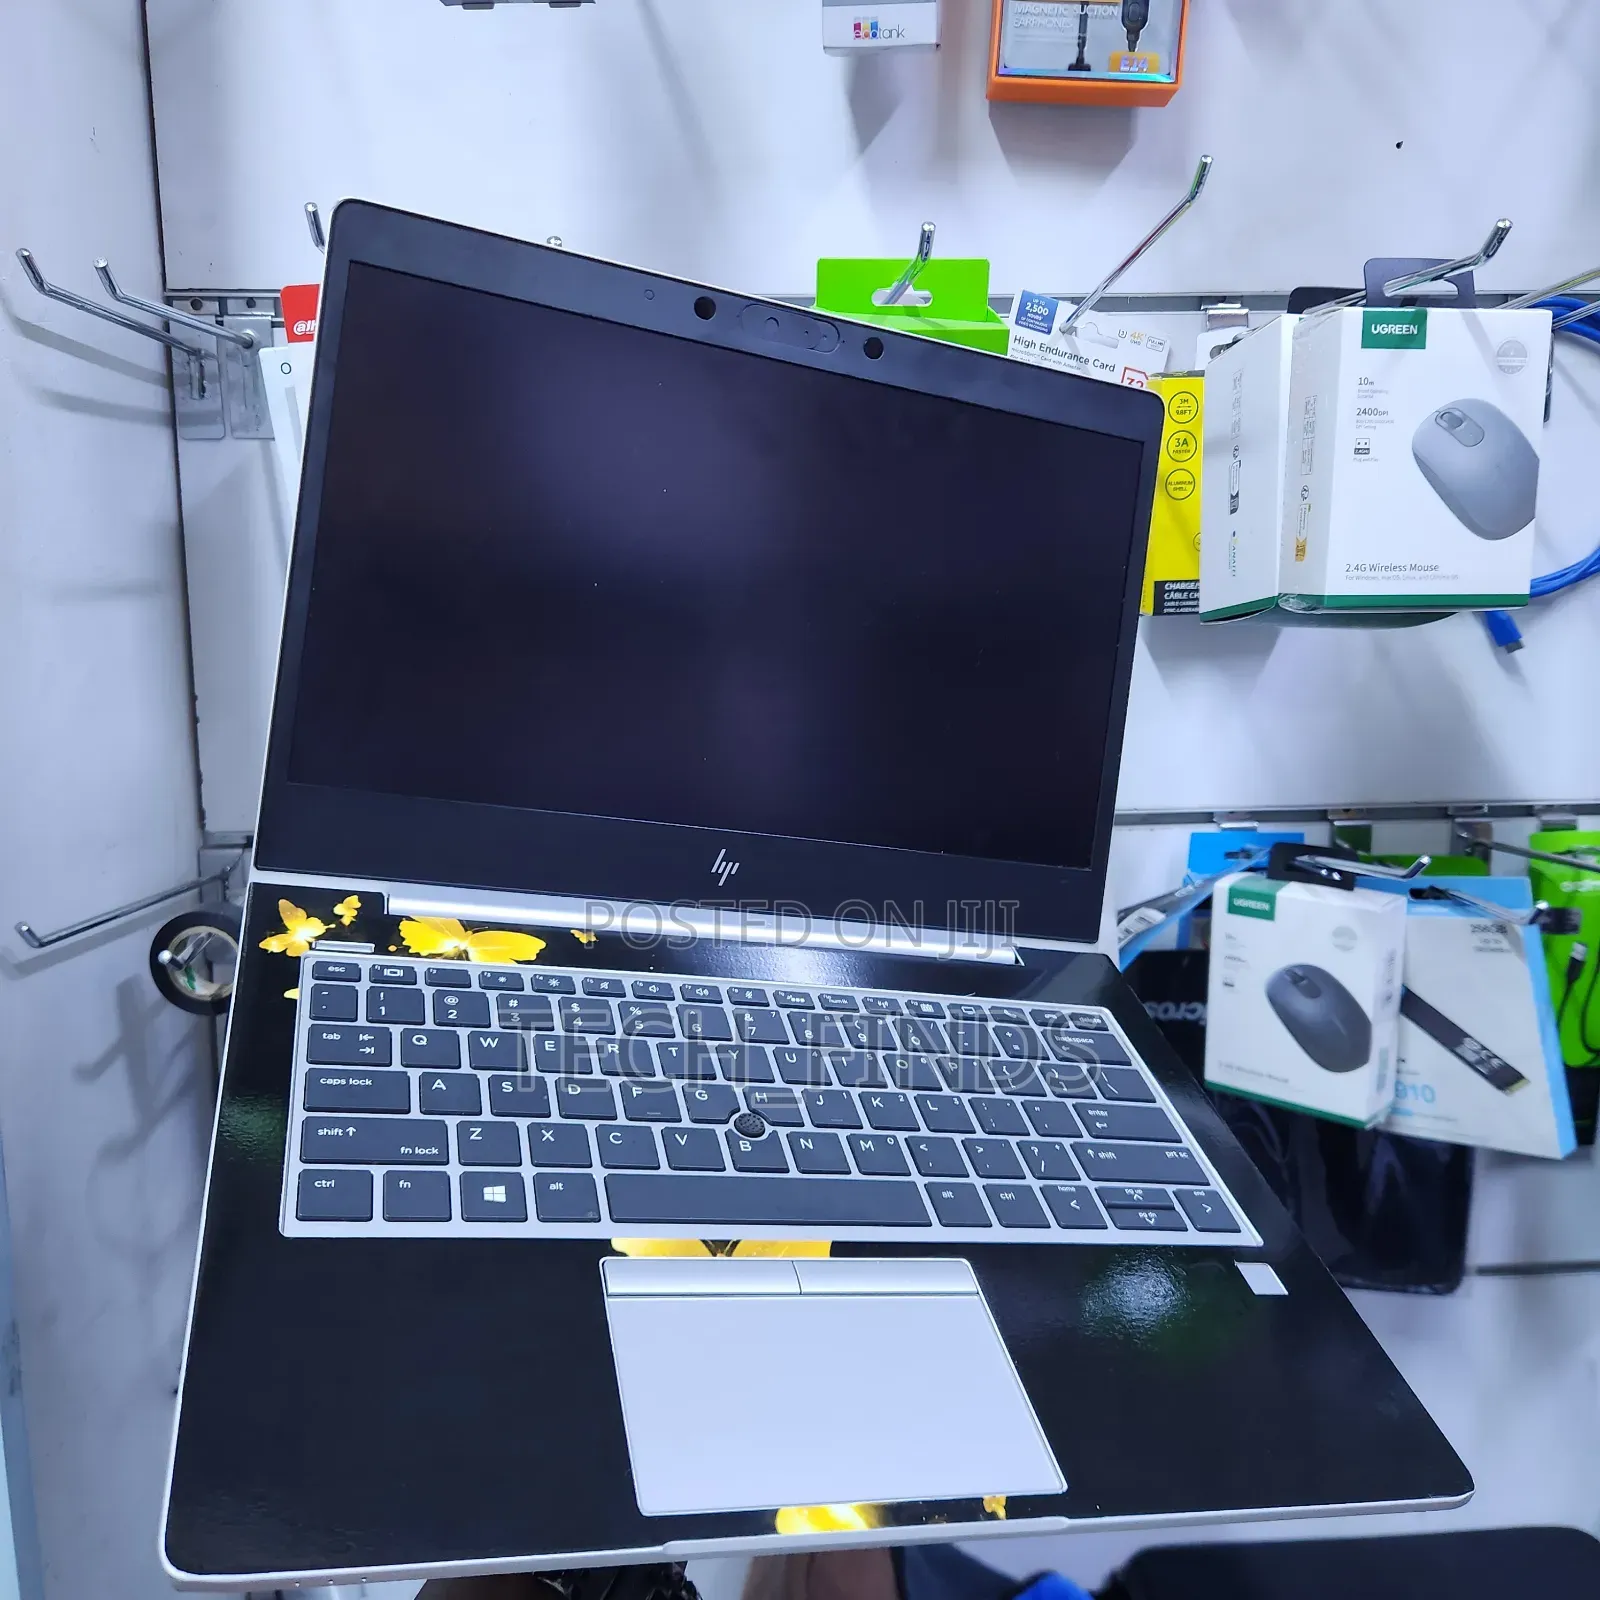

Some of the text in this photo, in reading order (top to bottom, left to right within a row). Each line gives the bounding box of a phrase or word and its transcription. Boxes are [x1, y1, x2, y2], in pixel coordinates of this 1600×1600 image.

[1014, 4, 1119, 17] MAGNETIC SUCTION
[1120, 55, 1149, 72] E14
[1025, 302, 1049, 316] 2,500
[1371, 323, 1418, 335] UGREEN
[1013, 334, 1036, 350] High
[1039, 343, 1090, 365] Endurance
[1092, 358, 1116, 373] Card
[1175, 438, 1189, 448] 3A
[1345, 562, 1440, 573] 2.4G Wireless Mouse
[1233, 897, 1271, 912] UGREEN
[327, 965, 346, 973] esc
[379, 1006, 386, 1016] 1
[447, 1010, 458, 1019] 2
[510, 1012, 521, 1022] 3
[573, 1017, 583, 1026] 4
[634, 1021, 644, 1030] 5
[691, 1024, 702, 1033] 6
[322, 1032, 341, 1041] tab
[747, 1027, 756, 1036] 7
[804, 1030, 814, 1039] 8
[412, 1034, 427, 1046] Q
[479, 1037, 498, 1048] W
[857, 1033, 867, 1042] 9
[1054, 1034, 1095, 1044] backspace
[545, 1040, 556, 1051] E
[608, 1044, 619, 1054] R
[668, 1047, 679, 1057] T
[728, 1050, 739, 1060] Y
[785, 1053, 797, 1063] U
[841, 1056, 848, 1067] I
[896, 1060, 908, 1069] O
[319, 1077, 373, 1086] caps lock
[432, 1079, 446, 1090] A
[502, 1081, 513, 1093] S
[568, 1084, 581, 1094] D
[632, 1086, 643, 1098] F
[695, 1089, 708, 1100] G
[755, 1092, 768, 1103] H
[816, 1095, 824, 1105] J
[871, 1096, 884, 1107] K
[926, 1100, 938, 1111] L
[1088, 1109, 1108, 1117] enter
[317, 1126, 344, 1137] shift
[469, 1128, 483, 1140] Z
[541, 1129, 555, 1142] X
[609, 1132, 623, 1145] C
[675, 1134, 688, 1146] V
[739, 1141, 751, 1151] B
[800, 1138, 813, 1150] N
[859, 1140, 875, 1151] M
[400, 1146, 439, 1155] fn lock
[1098, 1151, 1117, 1160] shift
[1165, 1151, 1178, 1159] prt
[314, 1179, 335, 1188] ctrl
[399, 1180, 411, 1189] fn
[549, 1182, 564, 1191] alt
[942, 1190, 954, 1199] alt
[1000, 1192, 1015, 1200] ctrl
